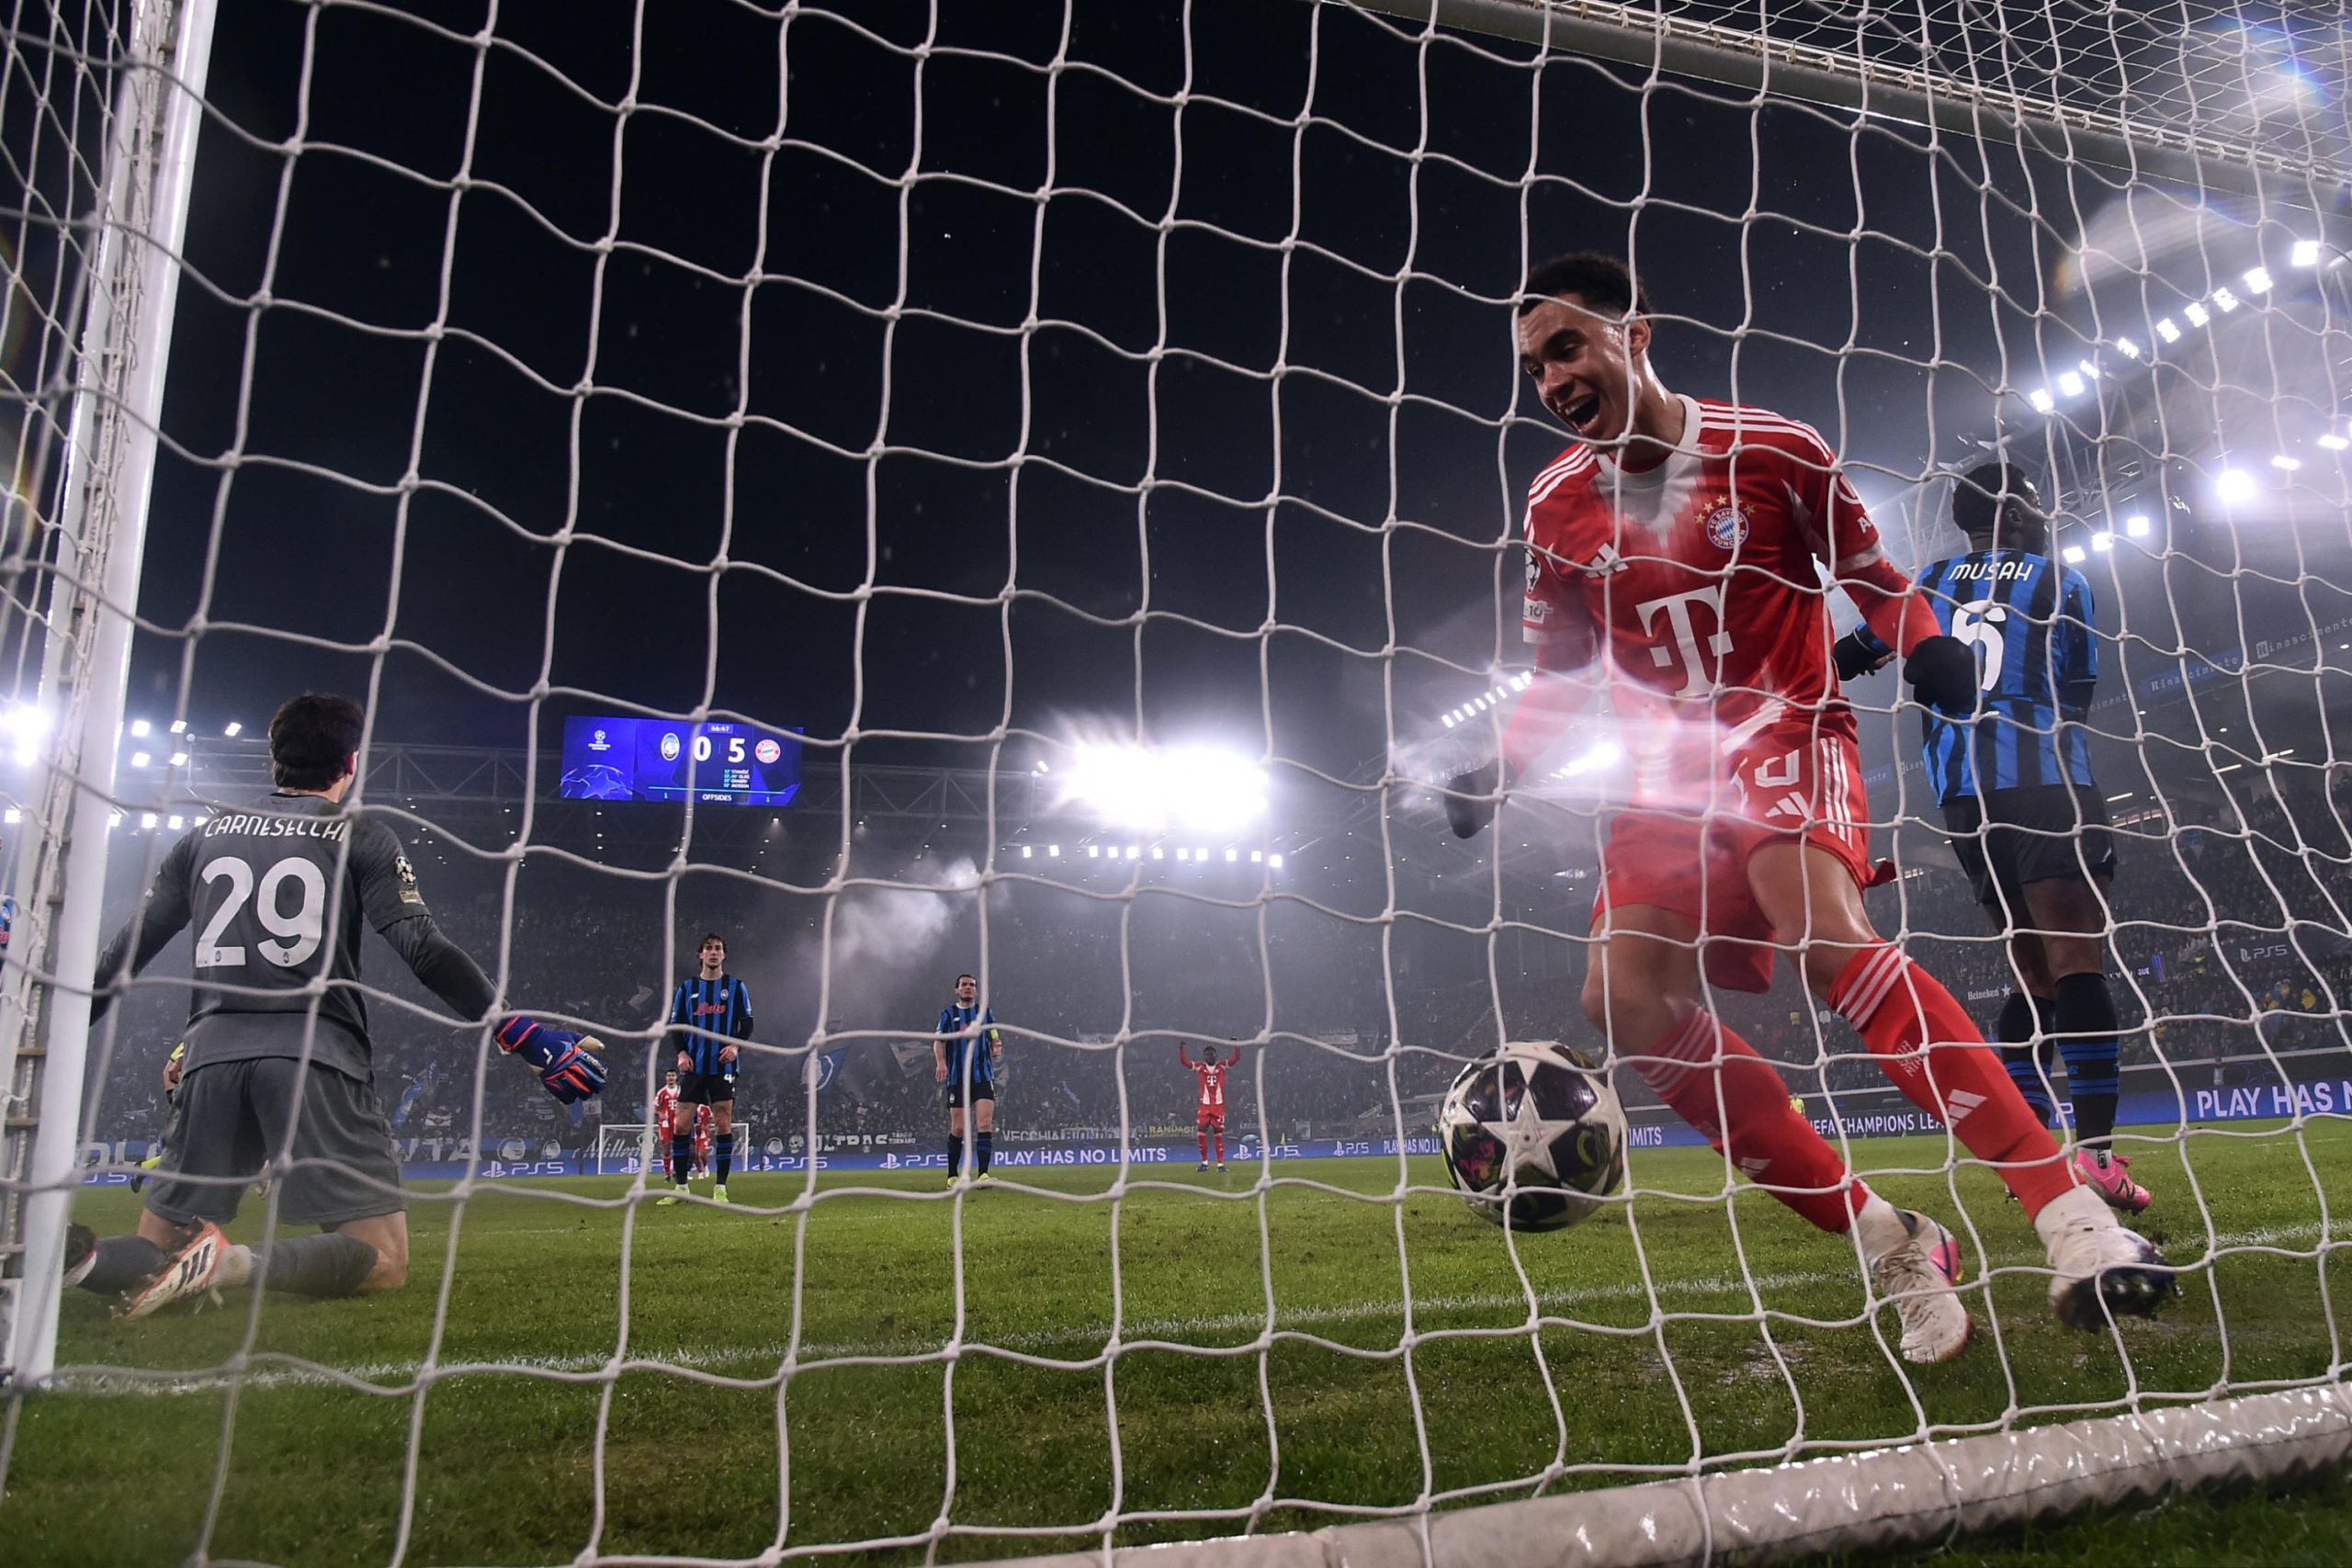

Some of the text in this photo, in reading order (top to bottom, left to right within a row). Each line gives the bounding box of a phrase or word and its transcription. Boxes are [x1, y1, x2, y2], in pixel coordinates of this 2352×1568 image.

[1948, 561, 2034, 581] MUSAH
[695, 736, 711, 761] 0
[728, 738, 745, 762] 5
[702, 794, 732, 802] OFFSIDES
[196, 856, 325, 968] 29
[2253, 944, 2288, 959] PS5
[1967, 987, 2000, 1001] Heineken
[2197, 1087, 2261, 1118] PLAY
[2272, 1082, 2334, 1114] HAS
[1838, 1113, 1916, 1134] CHAMPIONS
[1629, 1126, 1662, 1146] IMITS
[1256, 1145, 1299, 1156] PS5
[1346, 1142, 1369, 1154] PS5
[1419, 1138, 1430, 1153] NO
[778, 1156, 828, 1169] PS5
[905, 1154, 949, 1168] PS5
[994, 1147, 1167, 1166] PLAY HAS NO LIMITS
[512, 1161, 564, 1176] PS5
